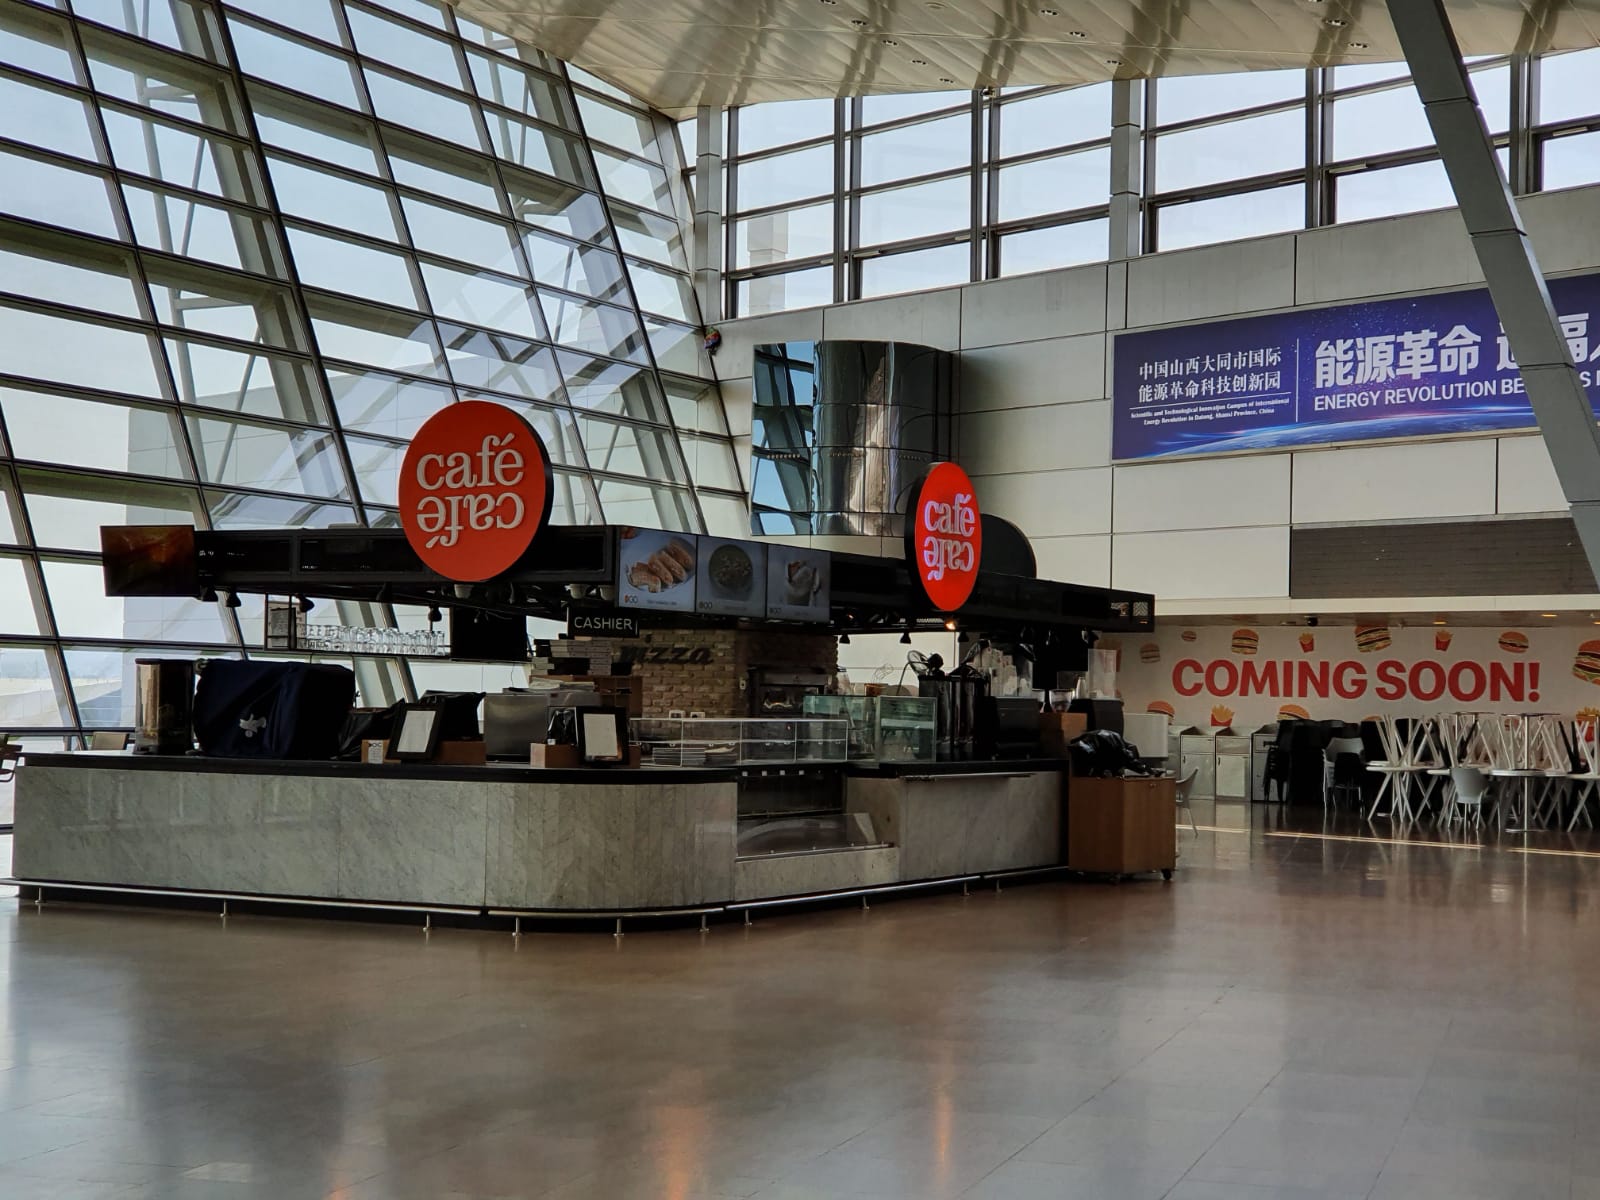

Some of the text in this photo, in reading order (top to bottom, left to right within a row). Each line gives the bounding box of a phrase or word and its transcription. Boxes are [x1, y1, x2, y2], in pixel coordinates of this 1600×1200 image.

[1139, 346, 1282, 381] 中国山西大同市国际
[1315, 324, 1482, 389] 能源革命
[1138, 370, 1281, 404] 能源革命科技创新园
[1314, 390, 1381, 412] ENERGY
[1384, 379, 1497, 405] REVOLUTION
[416, 432, 525, 491] café
[924, 493, 976, 538] café
[574, 616, 633, 630] CASHIER
[1172, 658, 1541, 703] COMING SOON!
